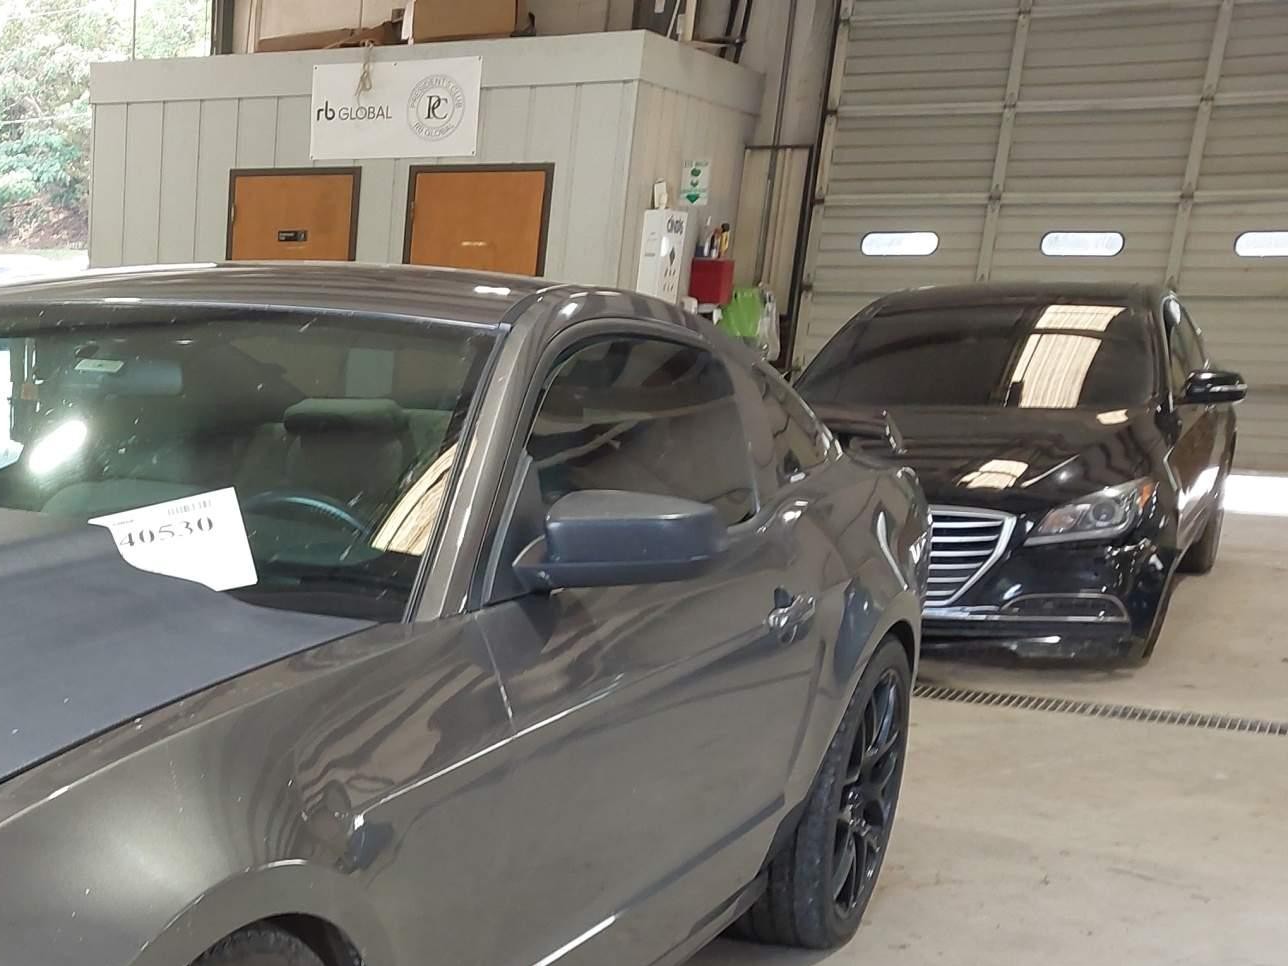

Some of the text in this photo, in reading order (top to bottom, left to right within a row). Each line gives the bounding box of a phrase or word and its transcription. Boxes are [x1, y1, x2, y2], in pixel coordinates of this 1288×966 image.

[316, 101, 393, 121] rb GLOBAL
[119, 516, 213, 547] 40530
